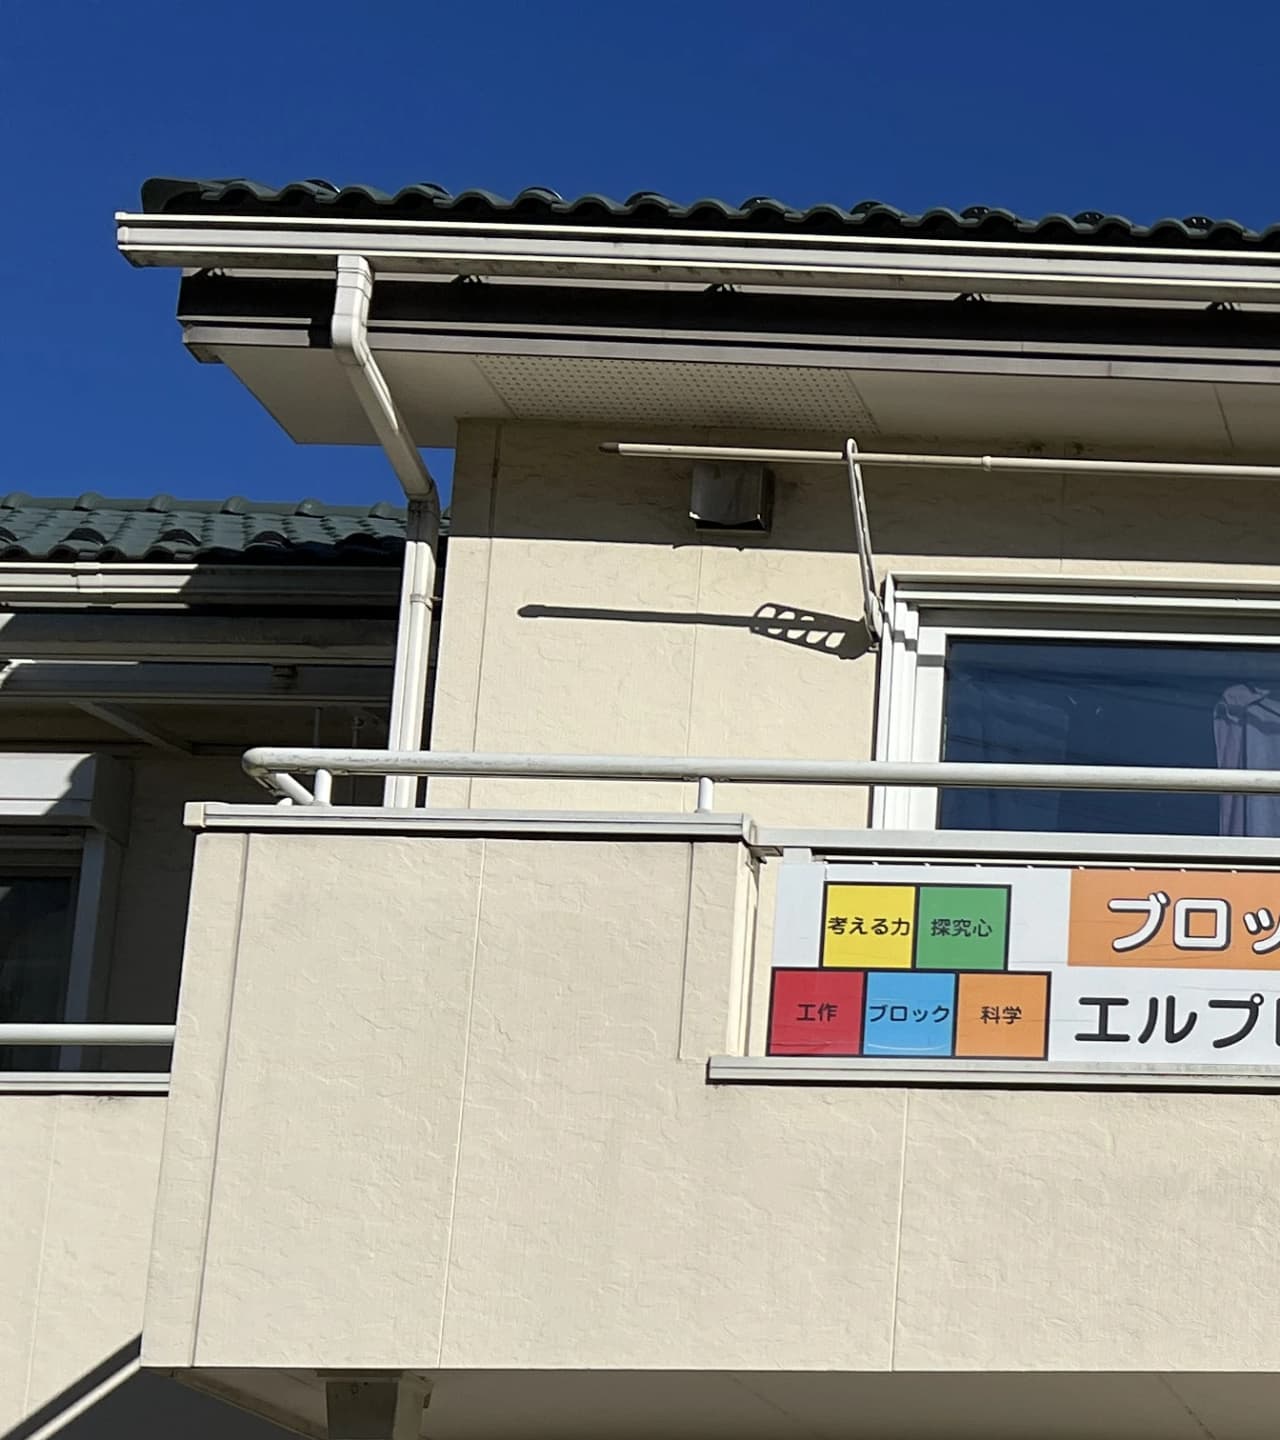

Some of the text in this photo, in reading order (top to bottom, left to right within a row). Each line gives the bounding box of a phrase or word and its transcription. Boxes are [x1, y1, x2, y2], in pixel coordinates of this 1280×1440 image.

[827, 916, 910, 936] 考える力
[930, 918, 993, 938] 探究心
[796, 1003, 838, 1022] 工作
[869, 1004, 950, 1023] ブロック
[980, 1005, 1022, 1025] 科学
